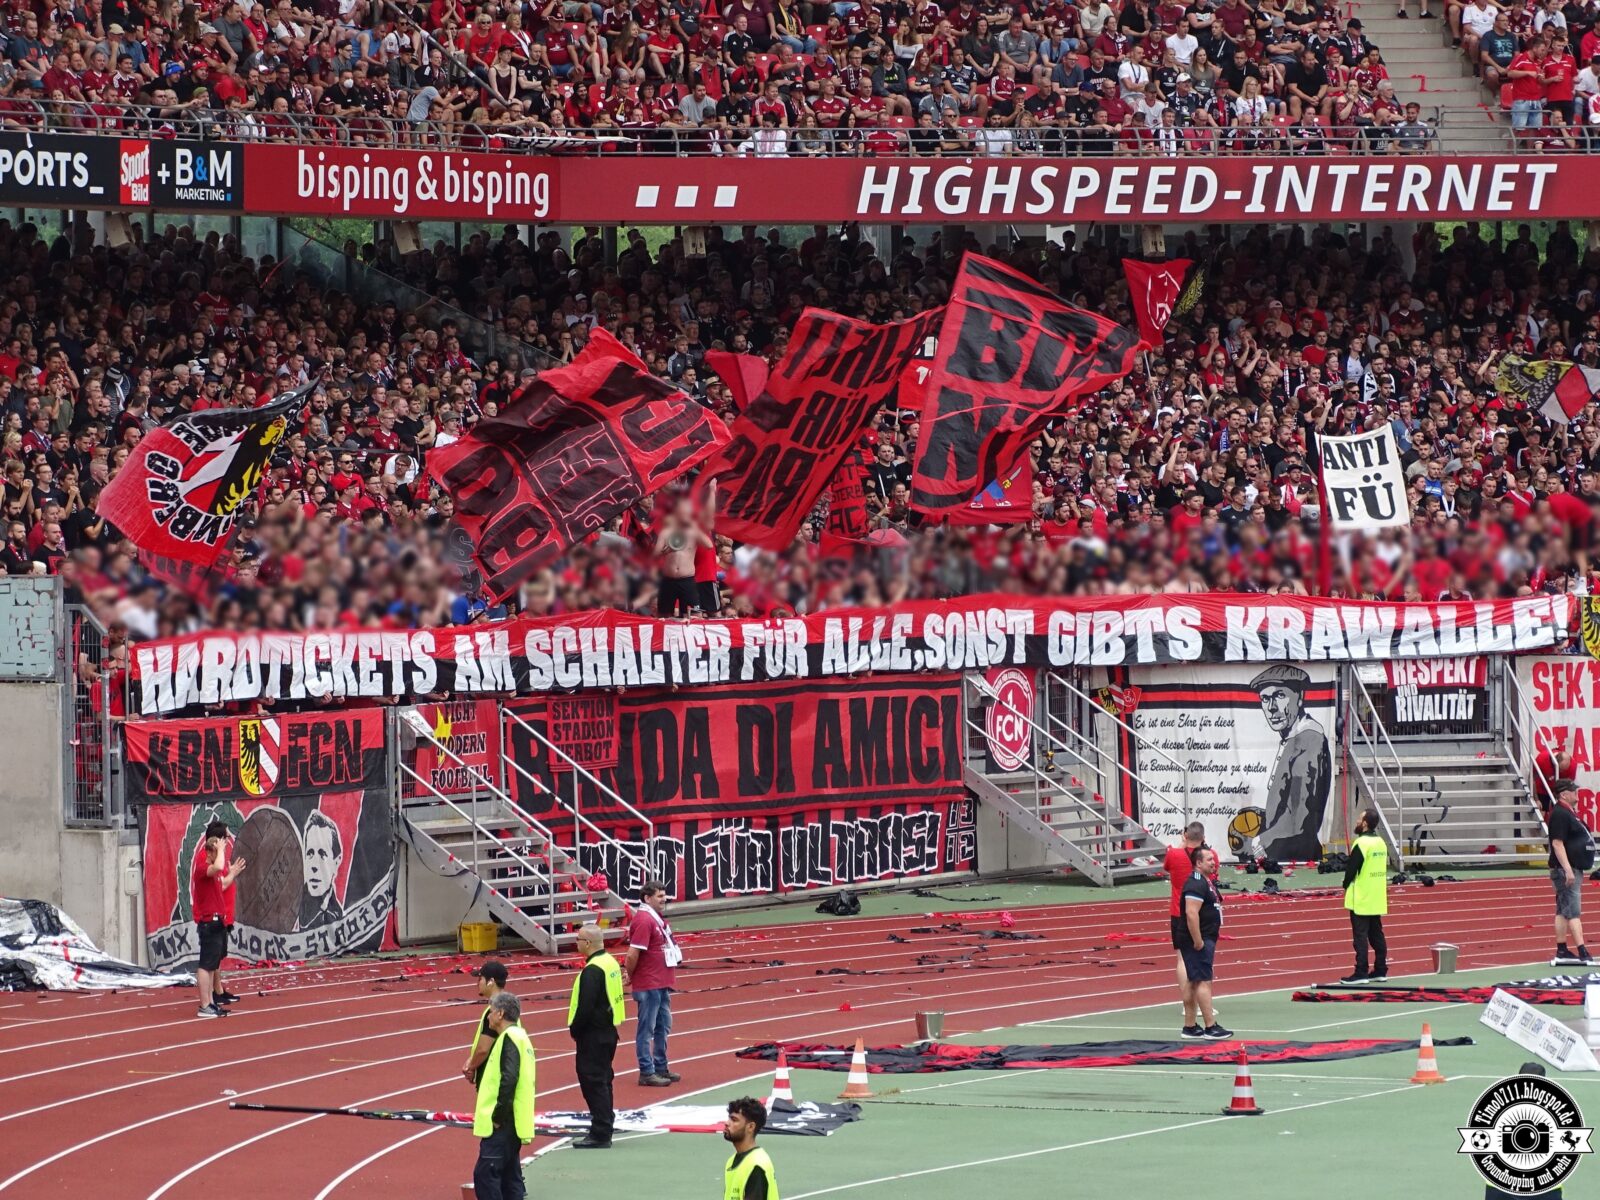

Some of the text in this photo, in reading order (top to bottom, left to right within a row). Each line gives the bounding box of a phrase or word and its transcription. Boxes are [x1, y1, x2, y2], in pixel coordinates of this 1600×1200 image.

[120, 146, 149, 185] Sport
[176, 149, 232, 187] B&M
[131, 184, 148, 201] Bild
[299, 149, 550, 217] bisping & bisping
[857, 164, 1557, 214] HIGHSPEED-INTERNET
[1322, 434, 1390, 470] ANTI
[1331, 473, 1397, 521] FÜ
[138, 632, 436, 714] HARDTICKETS
[454, 630, 516, 692] AM
[527, 622, 730, 690] SCHALTER
[740, 617, 809, 679] FÜR
[1048, 605, 1205, 666] GIBTS
[1225, 594, 1570, 662] KRAWALLE!
[1392, 655, 1480, 686] RESPEKT
[1397, 684, 1418, 697] UND
[444, 702, 477, 724] FIGHT
[553, 699, 614, 720] SEKTION
[1395, 689, 1477, 722] RIVALITÄT
[553, 720, 614, 742] STADION
[996, 714, 1024, 742] FCN
[1135, 713, 1235, 732] Es ist eine Ehre für diese
[286, 719, 364, 788] FCN
[436, 732, 486, 758] MODERN
[556, 740, 612, 763] VERBOT
[736, 703, 796, 797] DI
[813, 695, 962, 789] AMICI
[1185, 738, 1211, 750] Verein
[1214, 739, 1230, 750] und
[145, 726, 233, 795] KBN
[1186, 760, 1228, 775] Nürnbergs
[1230, 765, 1240, 776] zu
[1243, 762, 1267, 775] spielen
[431, 764, 493, 789] FOOTBALL
[1160, 782, 1172, 793] all
[1190, 784, 1215, 794] immer
[1217, 782, 1249, 795] bewahrt
[1195, 803, 1237, 818] großartige
[693, 818, 774, 895] FÜR
[780, 810, 942, 887] ULTRAS!
